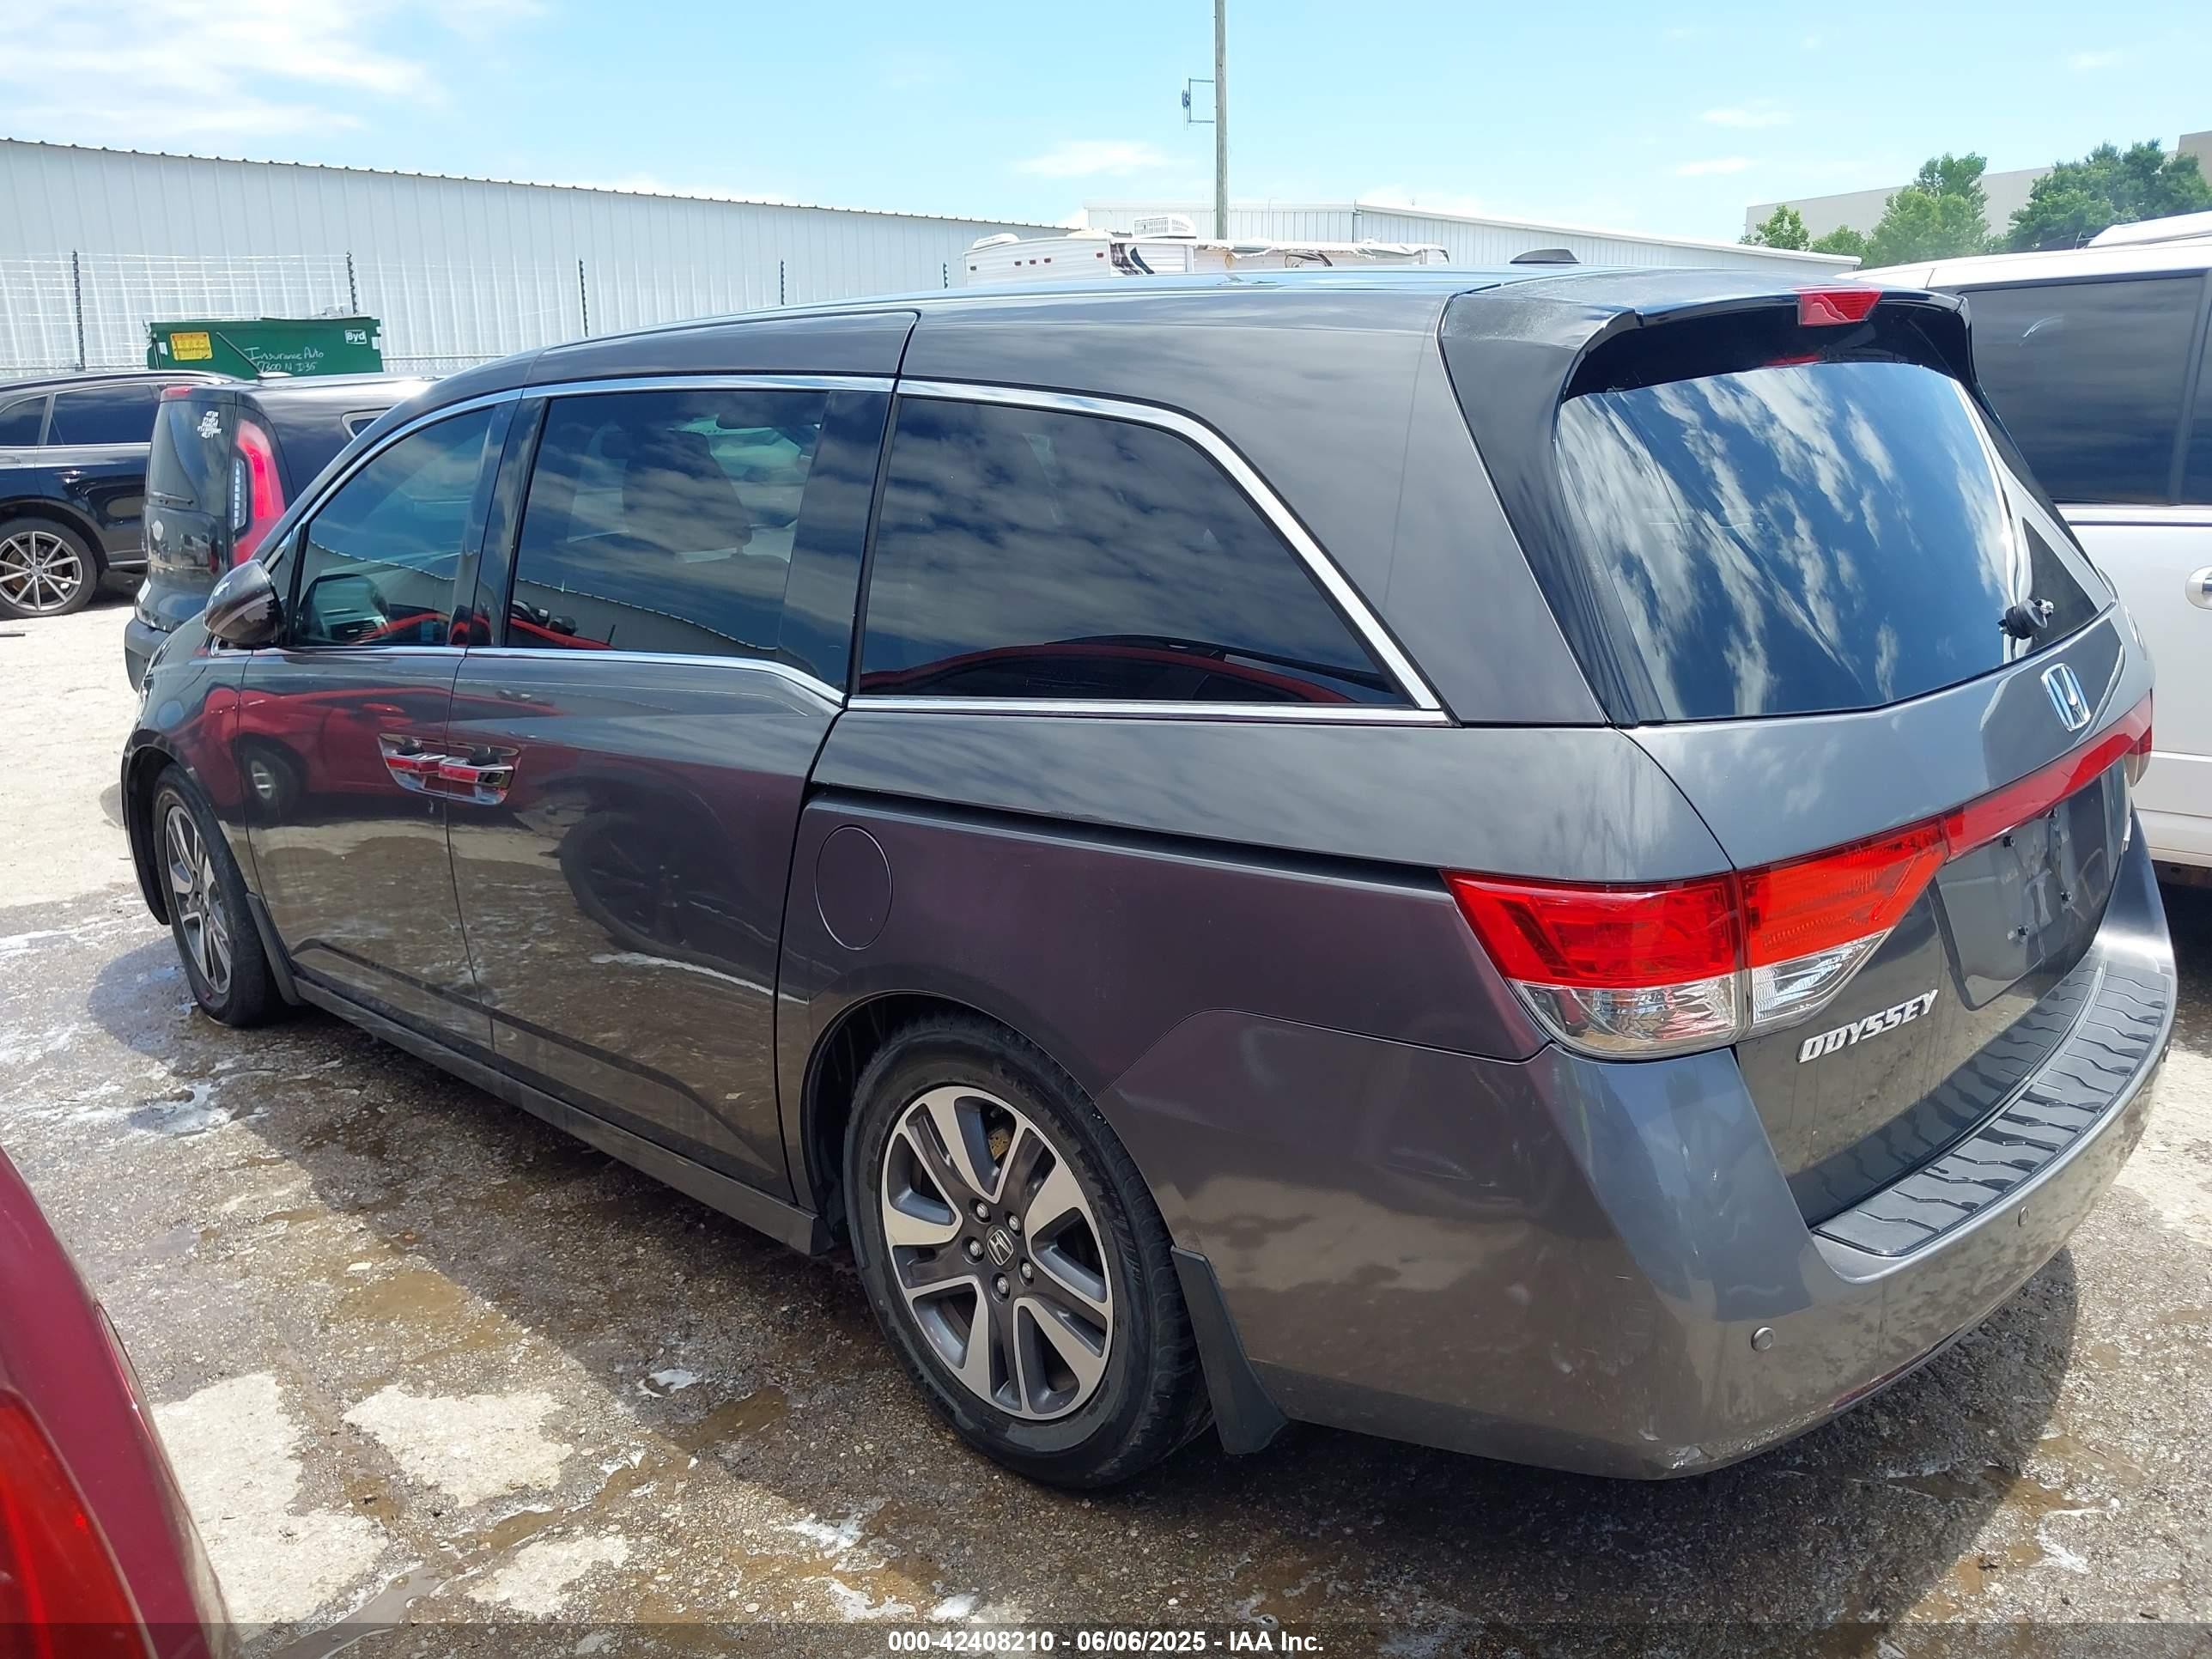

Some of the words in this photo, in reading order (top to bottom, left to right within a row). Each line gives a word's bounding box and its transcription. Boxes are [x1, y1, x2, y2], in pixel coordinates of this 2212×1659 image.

[304, 345, 325, 359] Auto
[284, 362, 293, 371] N
[1798, 988, 1939, 1064] ODYSSEY
